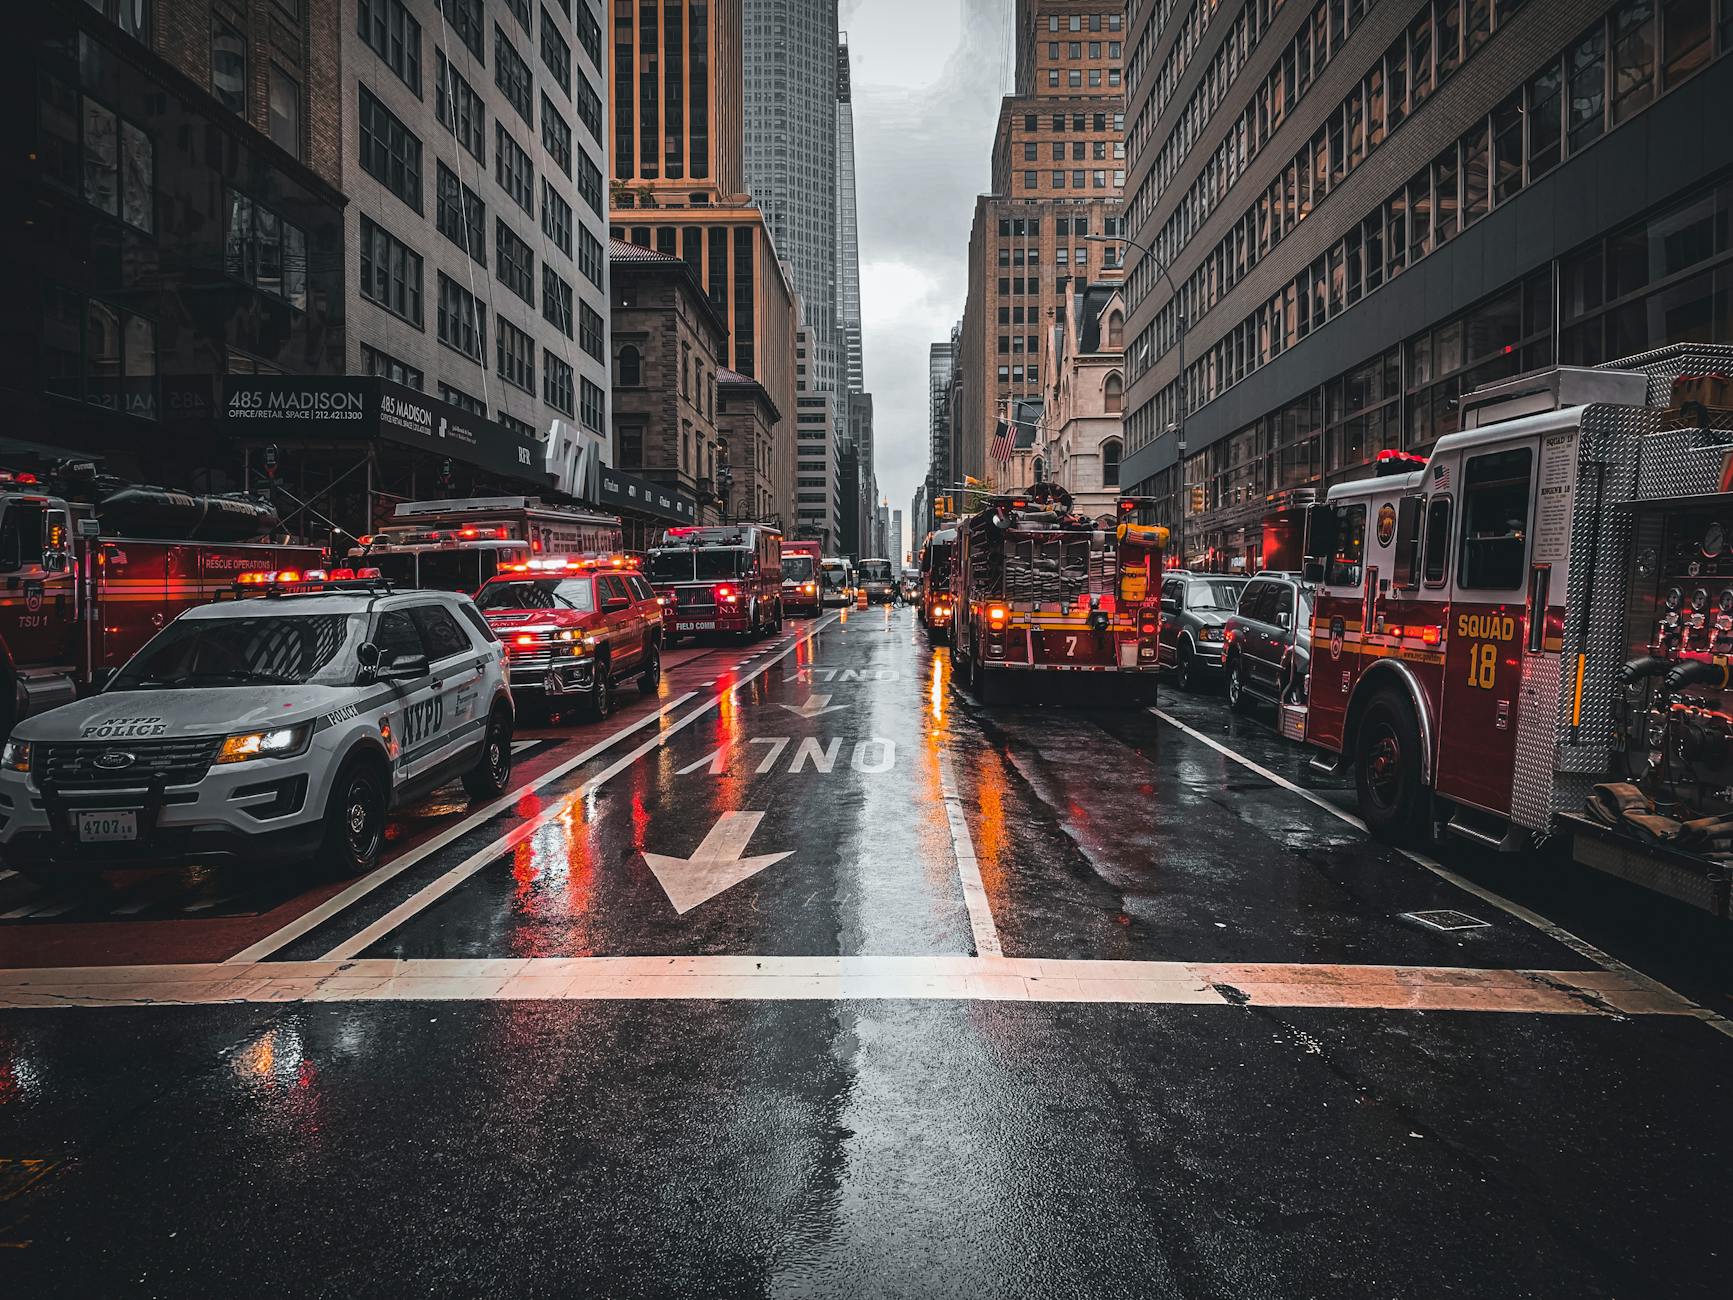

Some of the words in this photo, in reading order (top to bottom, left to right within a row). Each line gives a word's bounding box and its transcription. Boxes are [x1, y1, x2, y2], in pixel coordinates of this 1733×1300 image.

[229, 391, 262, 409] 485
[268, 391, 363, 410] MADISON
[228, 409, 283, 419] OFFICE/RETAIL
[285, 410, 310, 419] SPACE
[315, 411, 363, 420] 212.421.1300
[380, 394, 395, 414] 485
[396, 399, 432, 427] MADISON
[518, 446, 531, 465] RFR
[205, 559, 232, 569] RESCUE
[233, 559, 271, 570] OPERATIONS
[19, 615, 40, 628] TSU
[676, 622, 694, 631] FIELD
[695, 621, 715, 630] COMM
[1458, 613, 1516, 642] SQUAD
[1065, 635, 1078, 657] 7
[1467, 642, 1498, 690] 18
[102, 717, 161, 725] NYPD
[329, 704, 358, 726] POLICE
[402, 694, 444, 747] NYPD
[81, 724, 167, 738] POLICE
[675, 737, 896, 774] ONLY
[84, 820, 119, 835] 4707
